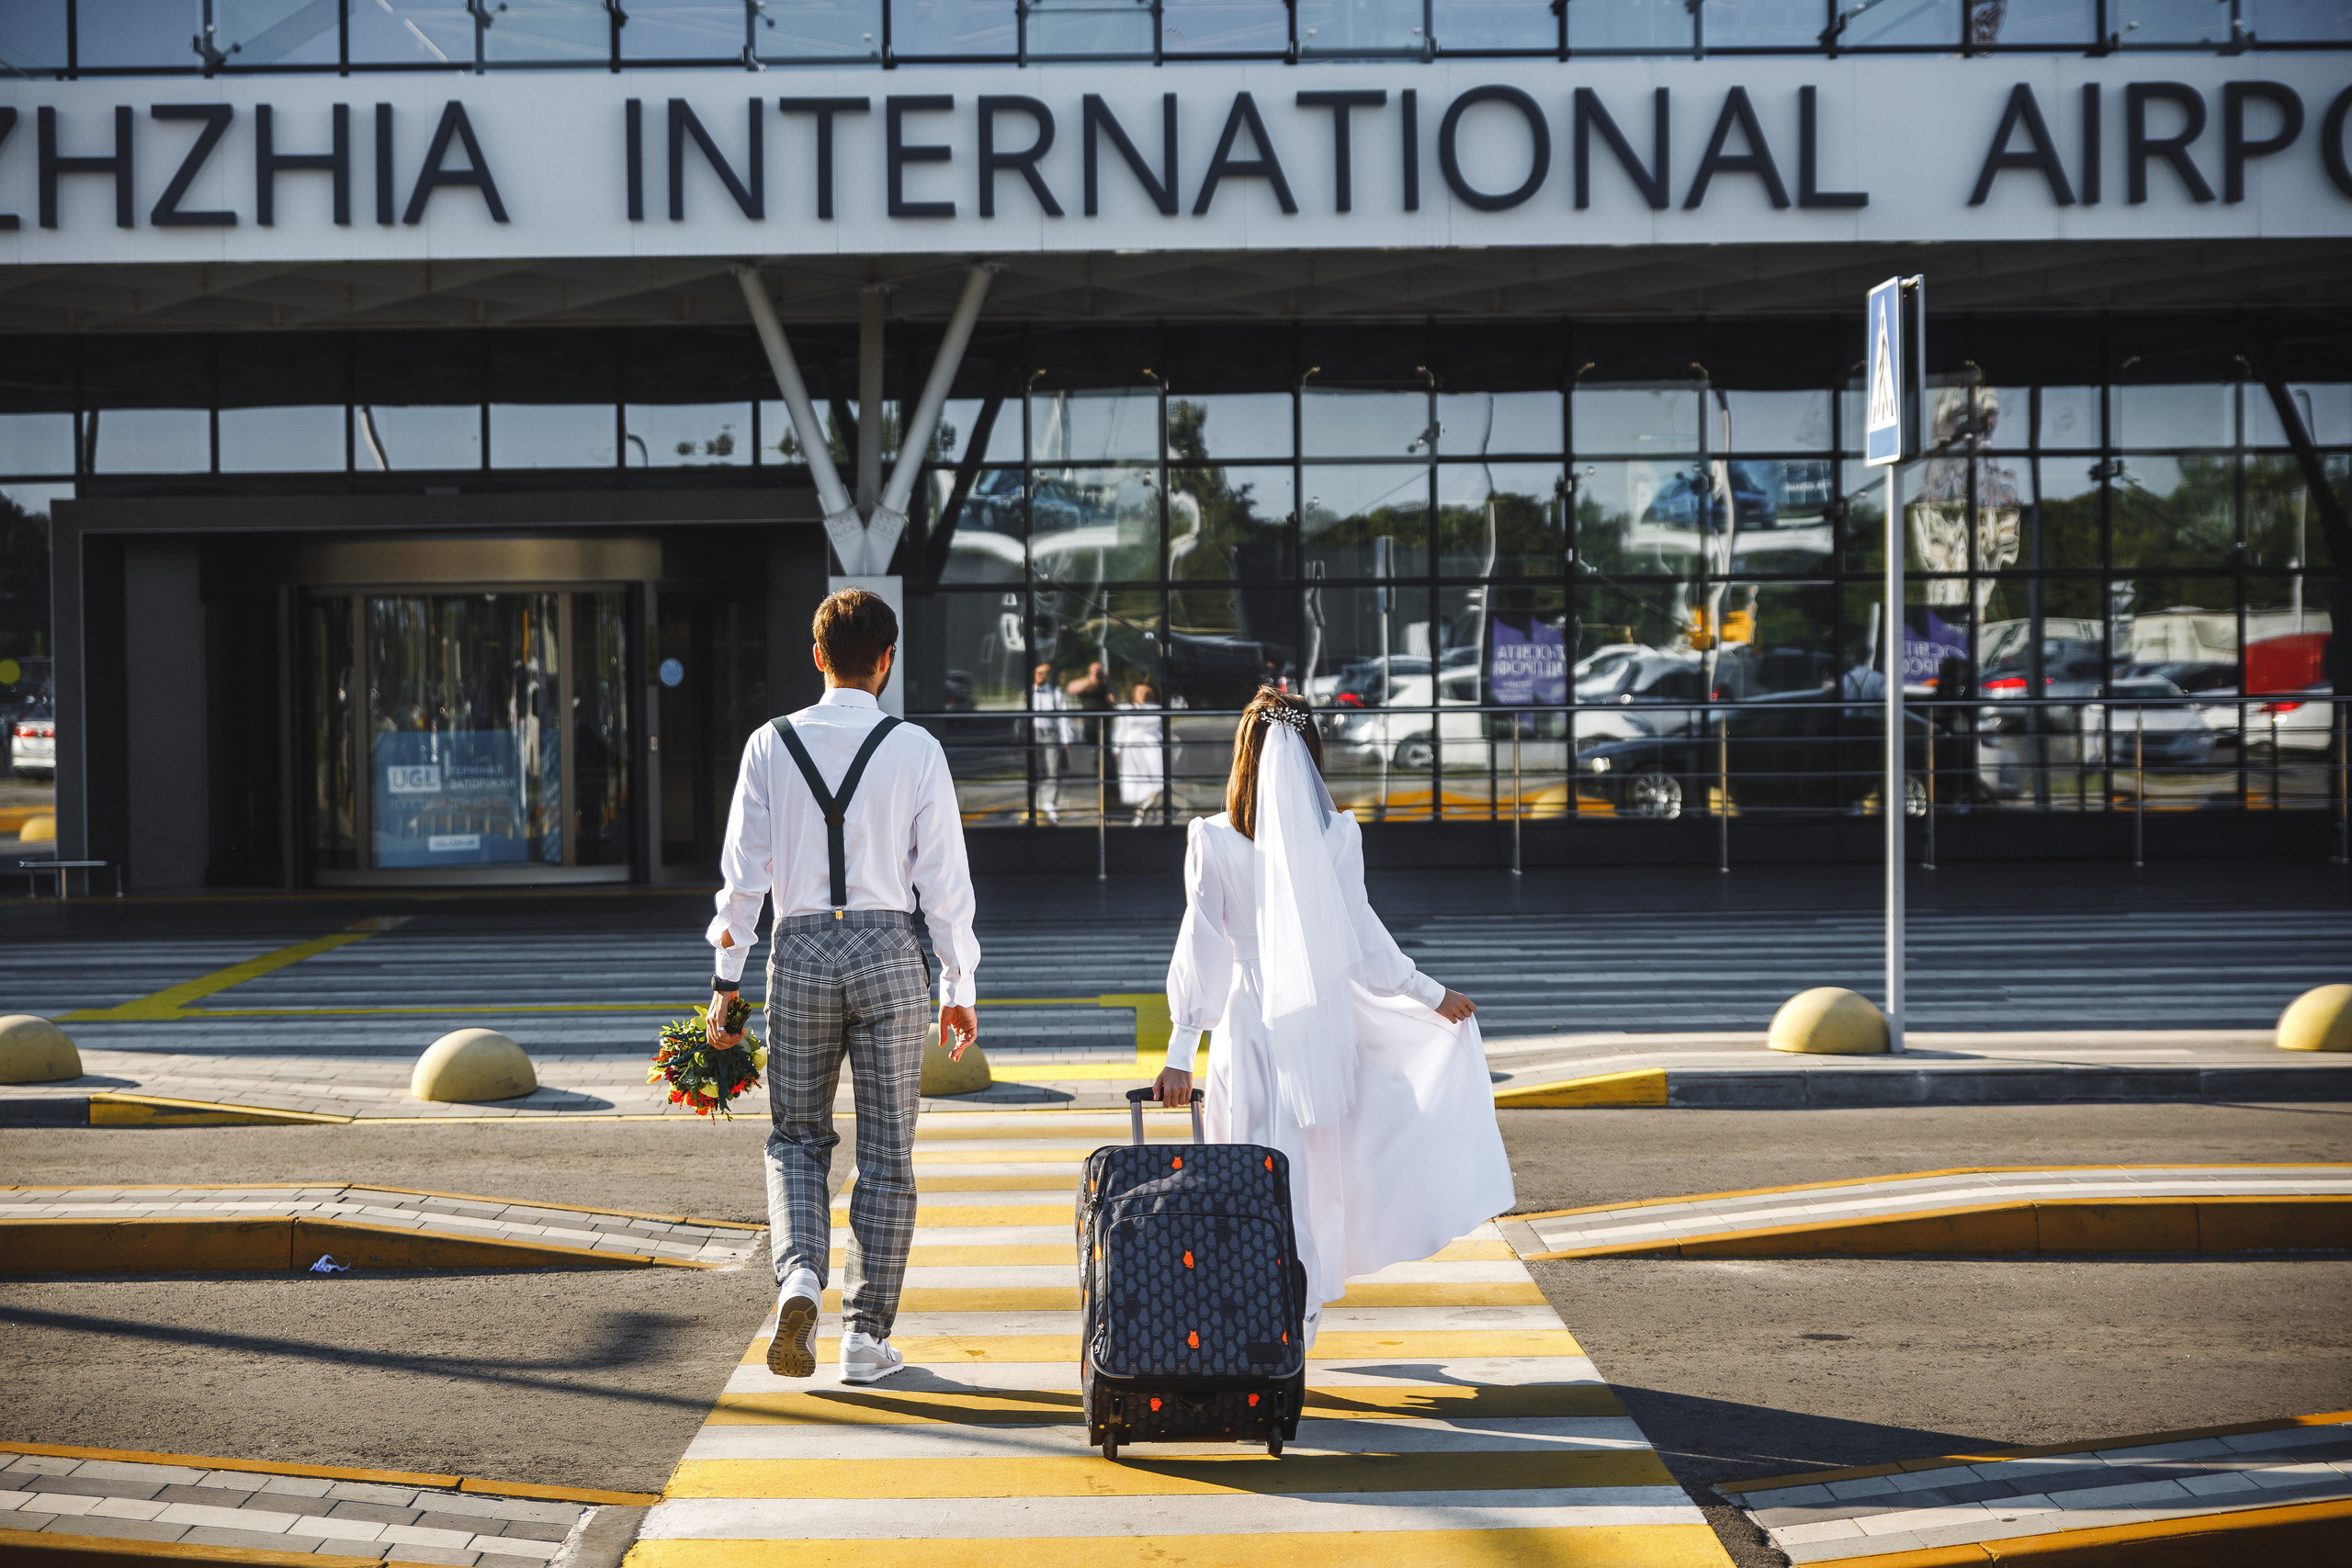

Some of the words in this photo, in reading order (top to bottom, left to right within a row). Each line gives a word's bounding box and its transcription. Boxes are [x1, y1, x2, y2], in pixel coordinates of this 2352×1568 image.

[0, 100, 512, 231] HZHIA
[625, 84, 1871, 223] INTERNATIONAL
[1965, 79, 2352, 209] AIRP
[392, 768, 440, 788] UGL
